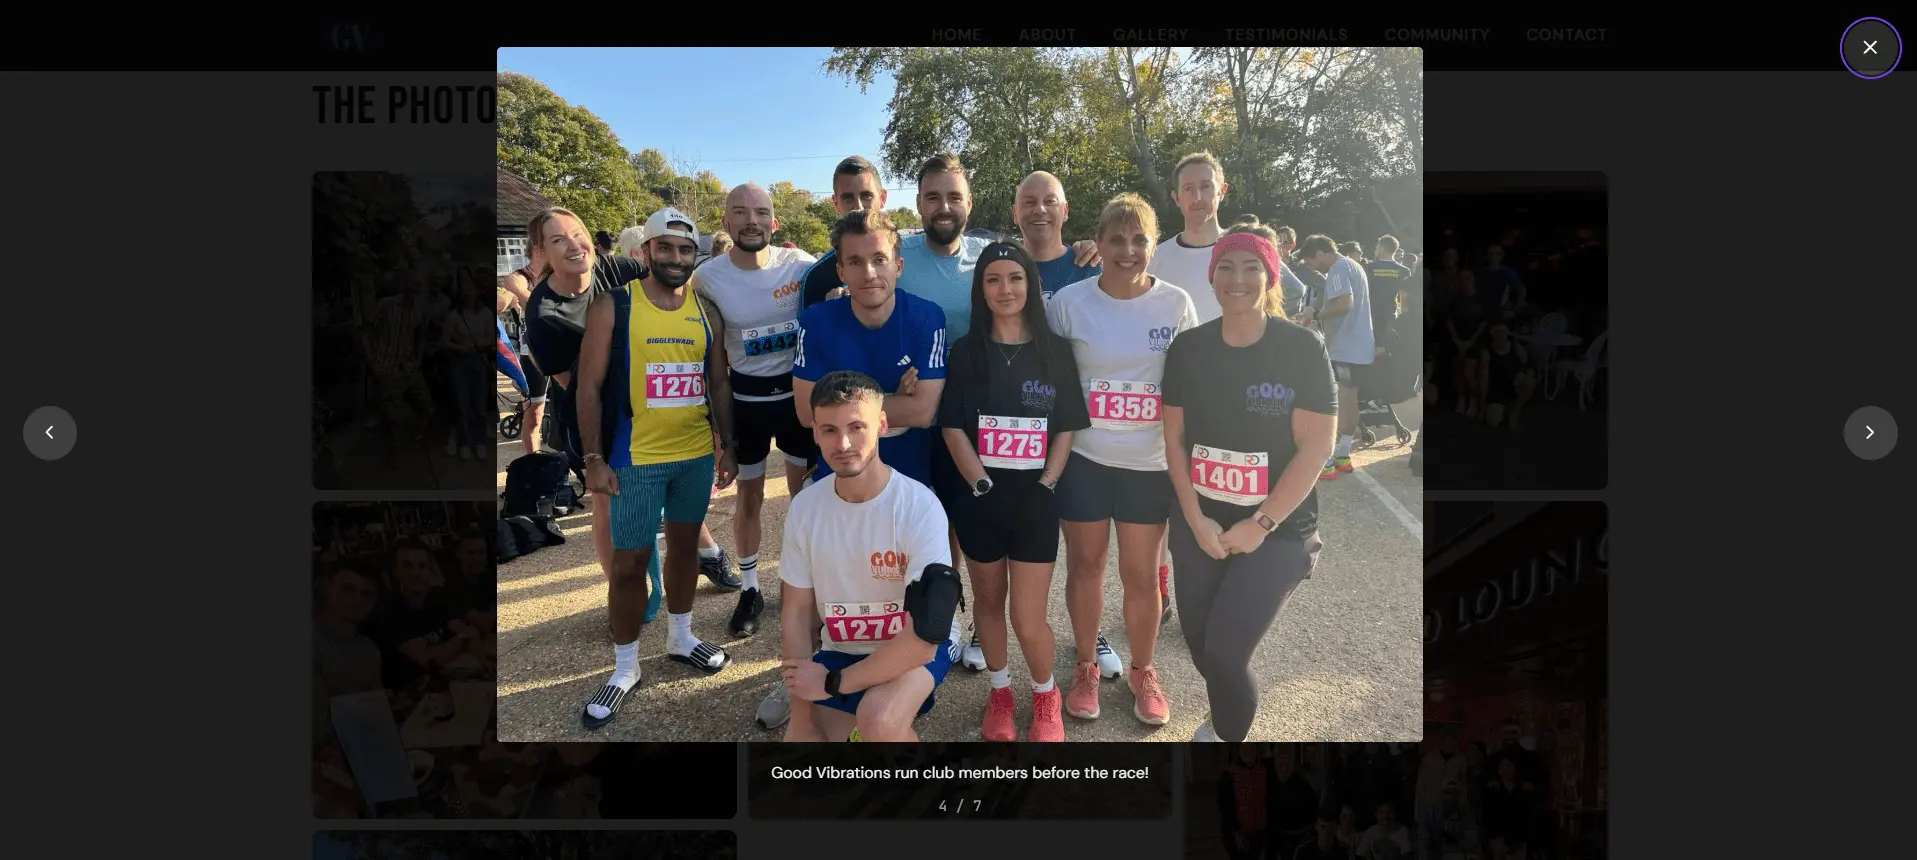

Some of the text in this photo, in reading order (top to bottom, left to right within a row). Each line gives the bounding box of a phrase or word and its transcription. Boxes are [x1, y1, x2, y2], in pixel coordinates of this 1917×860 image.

[646, 337, 695, 346] BIGGLESWADE
[748, 332, 798, 354] 3442
[651, 375, 702, 397] 1276
[1095, 394, 1158, 420] 1358
[983, 431, 1043, 457] 1275
[1195, 462, 1259, 493] 1401
[833, 615, 904, 641] 1274
